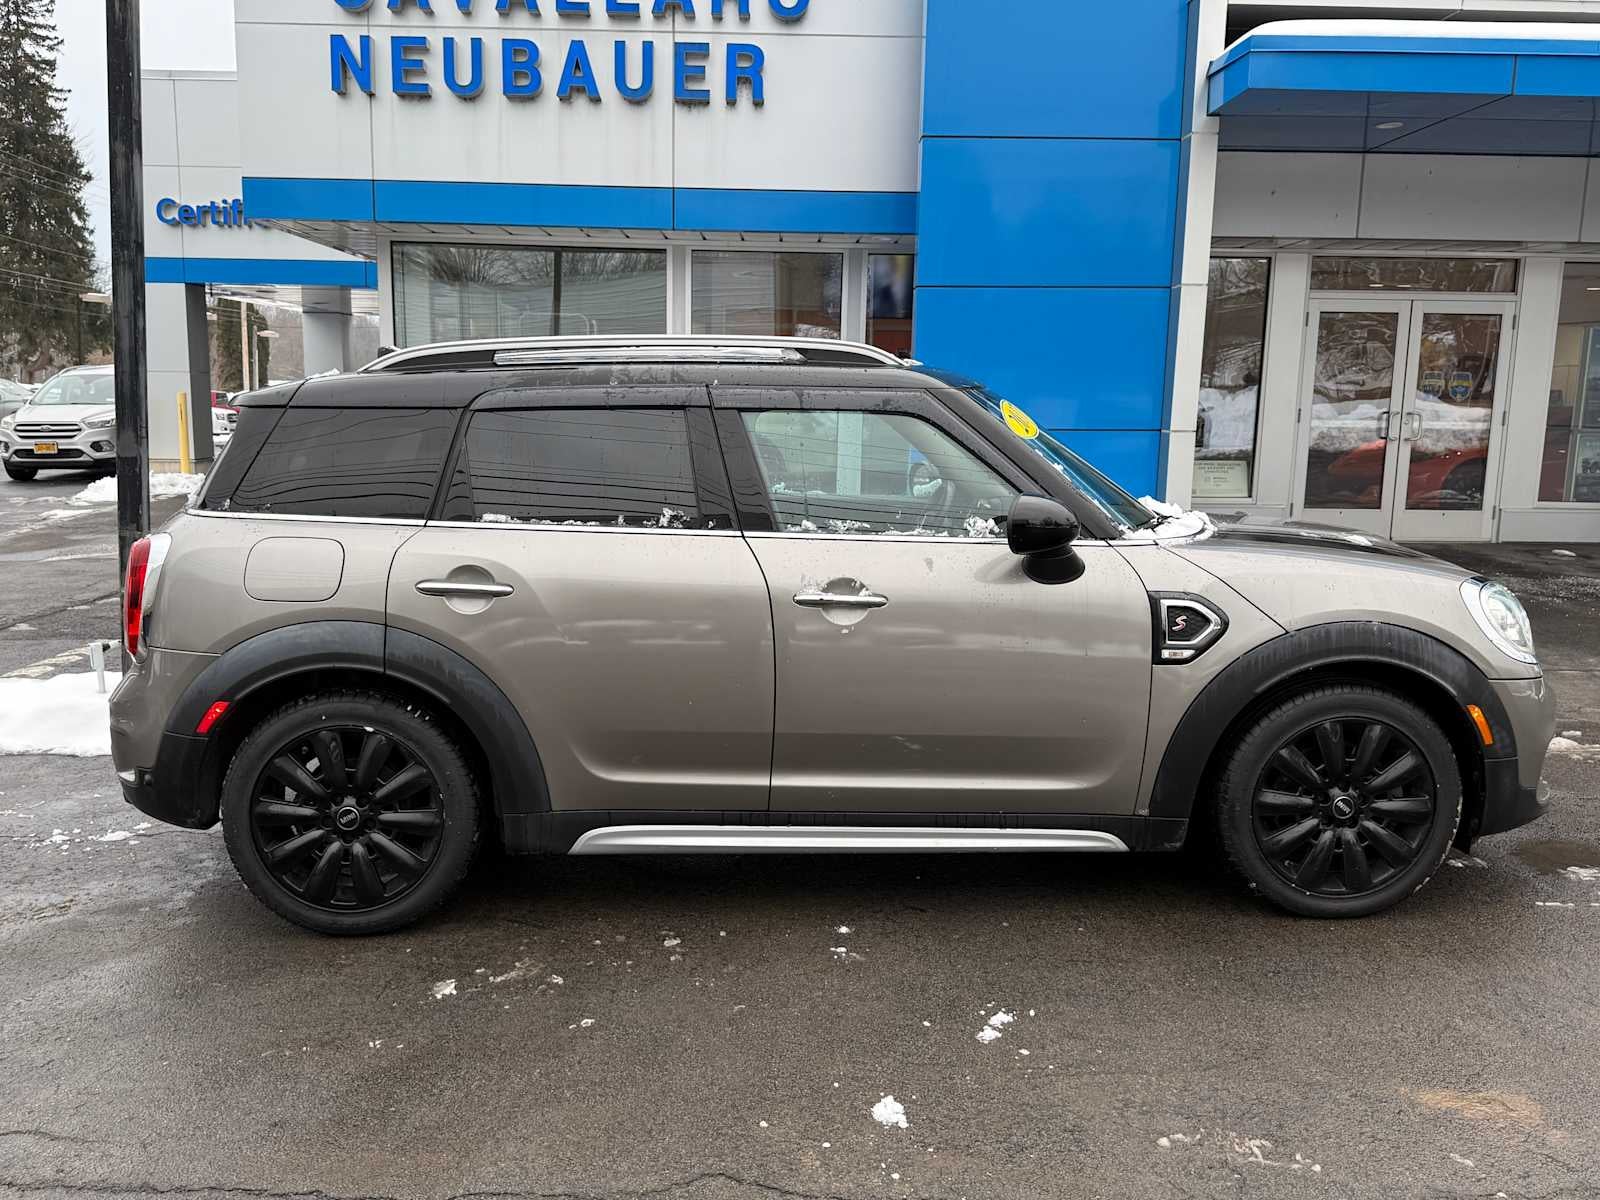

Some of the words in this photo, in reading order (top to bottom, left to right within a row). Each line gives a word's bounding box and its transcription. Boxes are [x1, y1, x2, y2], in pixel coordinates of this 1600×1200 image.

[330, 34, 765, 106] NEUBAUER
[156, 198, 250, 227] Certif
[1171, 615, 1188, 632] S
